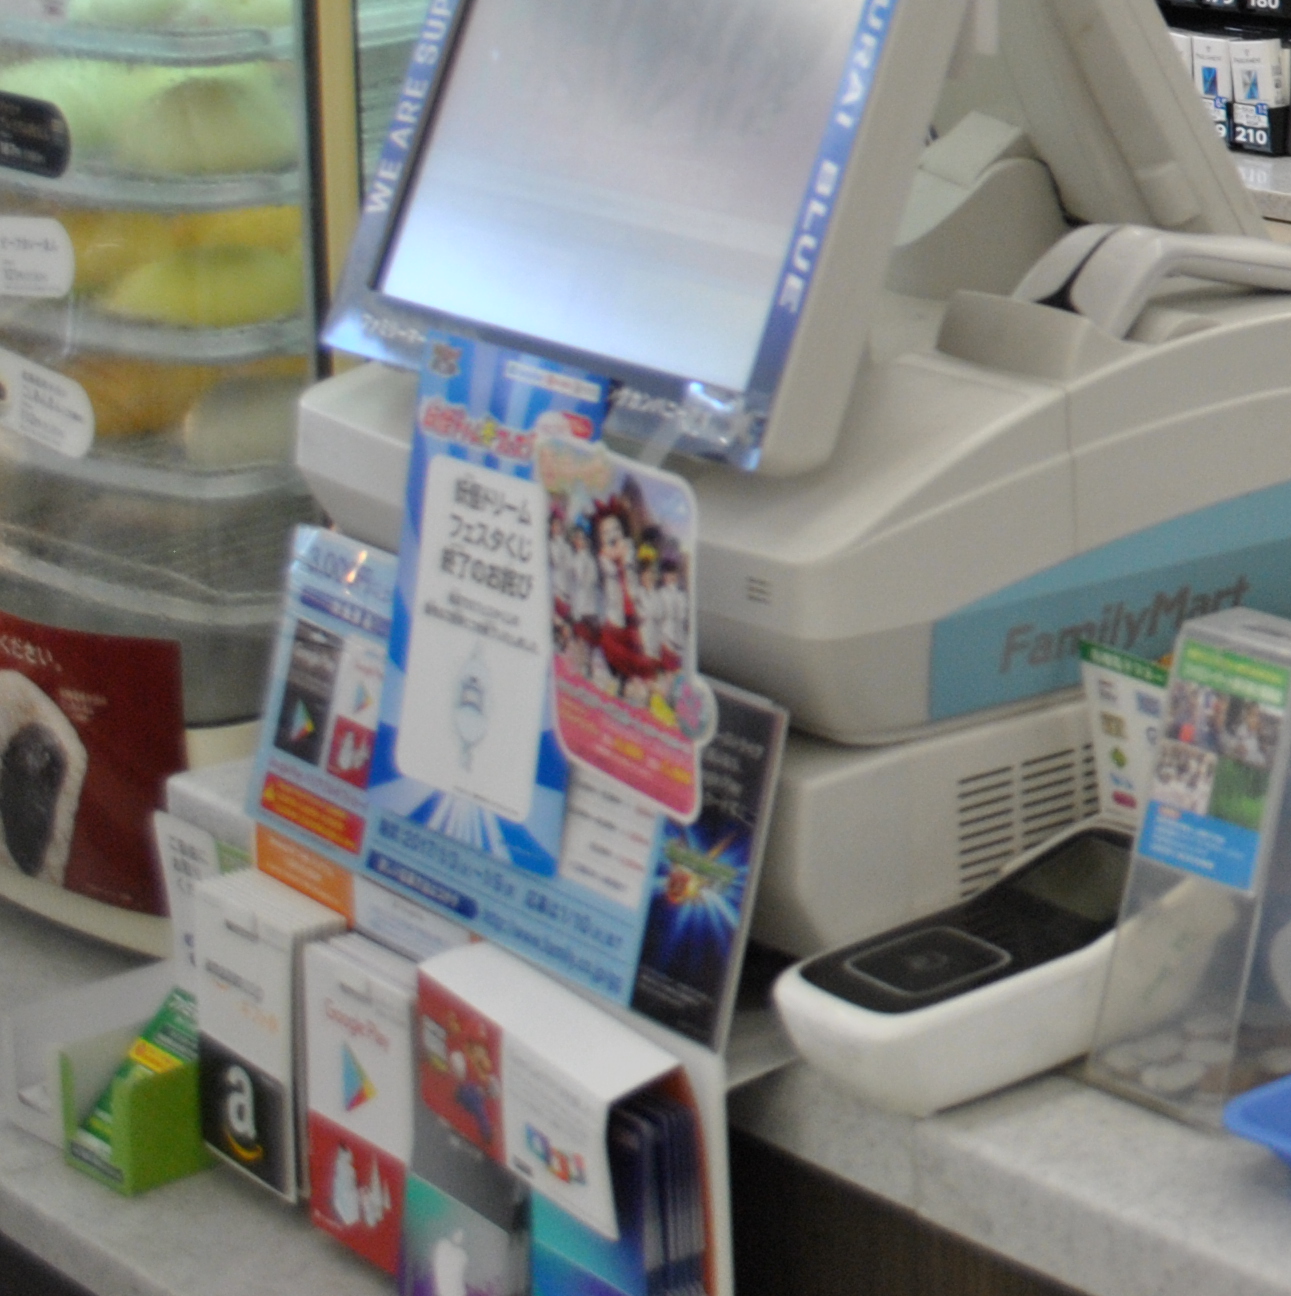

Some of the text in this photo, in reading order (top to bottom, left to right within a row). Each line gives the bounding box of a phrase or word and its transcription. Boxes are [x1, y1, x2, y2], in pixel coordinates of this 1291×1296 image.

[366, 163, 398, 214] WE
[388, 75, 429, 154] ARE
[1235, 128, 1267, 144] 210
[780, 159, 835, 316] BLUE
[1000, 576, 1252, 674] FamilyMart
[325, 1005, 390, 1053] Google Play
[224, 1064, 258, 1136] a
